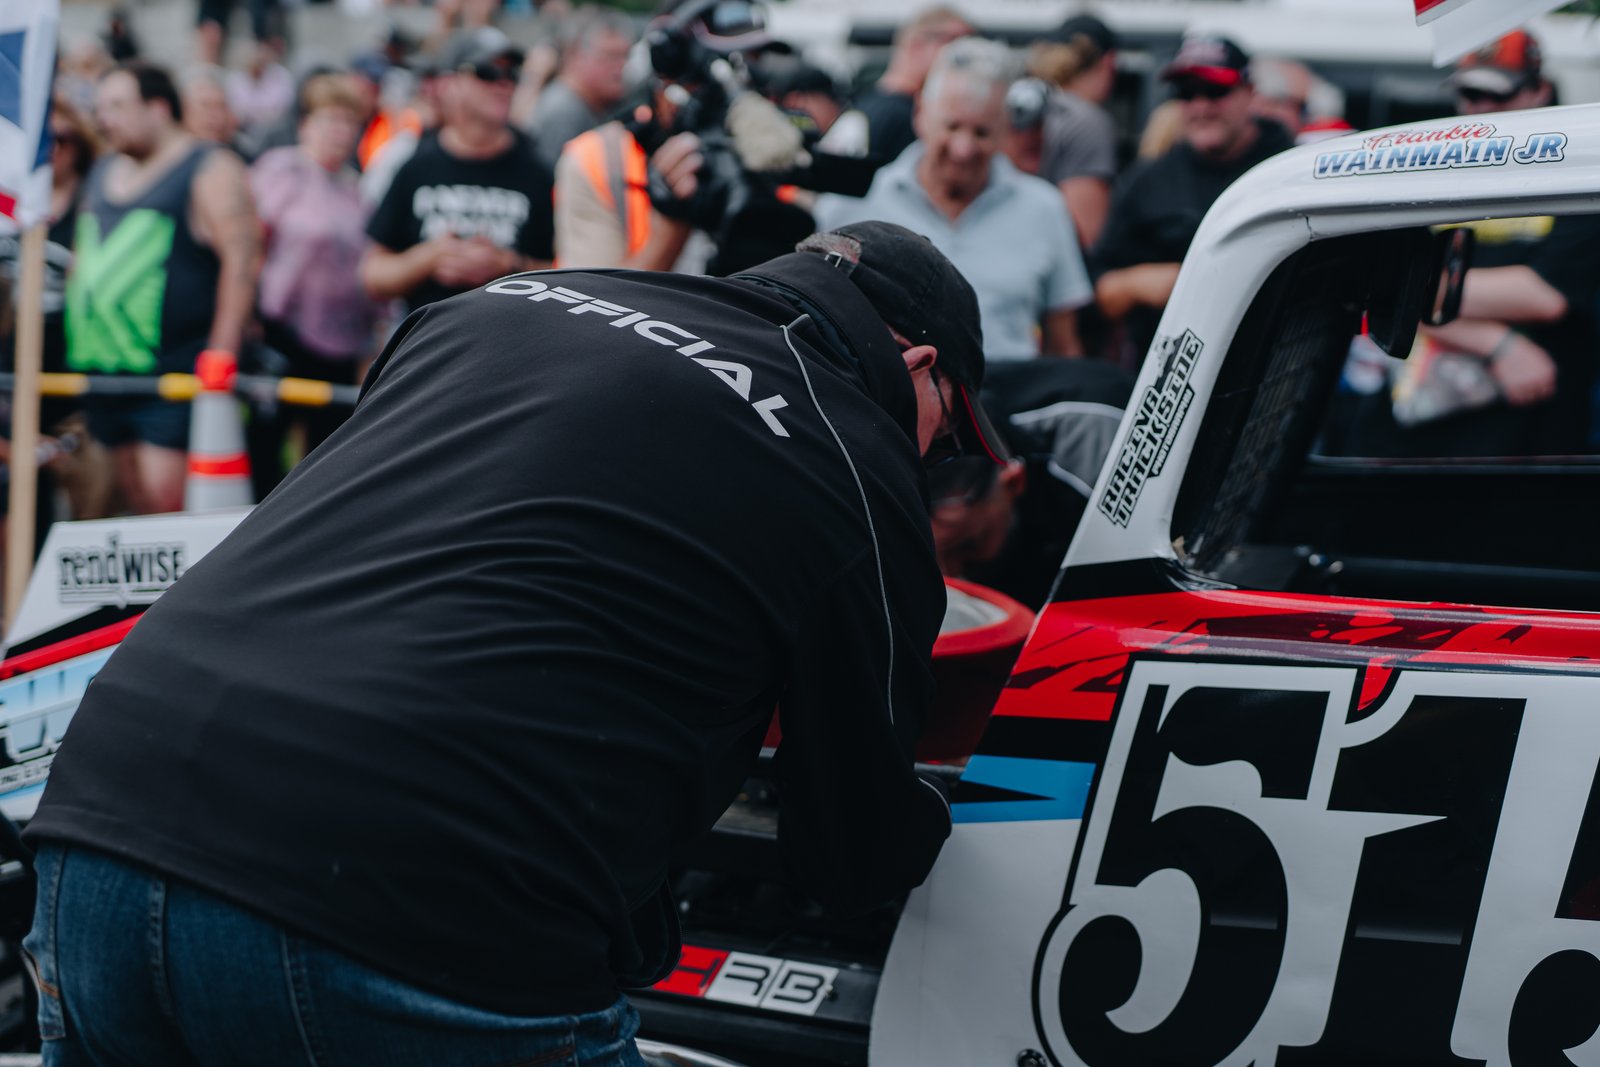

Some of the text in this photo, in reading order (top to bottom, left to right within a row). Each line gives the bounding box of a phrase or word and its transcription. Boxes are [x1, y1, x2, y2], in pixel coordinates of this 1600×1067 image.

[1316, 134, 1565, 176] WAINMAIN JR
[1368, 123, 1493, 150] Frankie
[484, 279, 791, 438] OFFICIAL
[1100, 387, 1160, 516] RACING
[1113, 332, 1201, 527] TRACKSIDE
